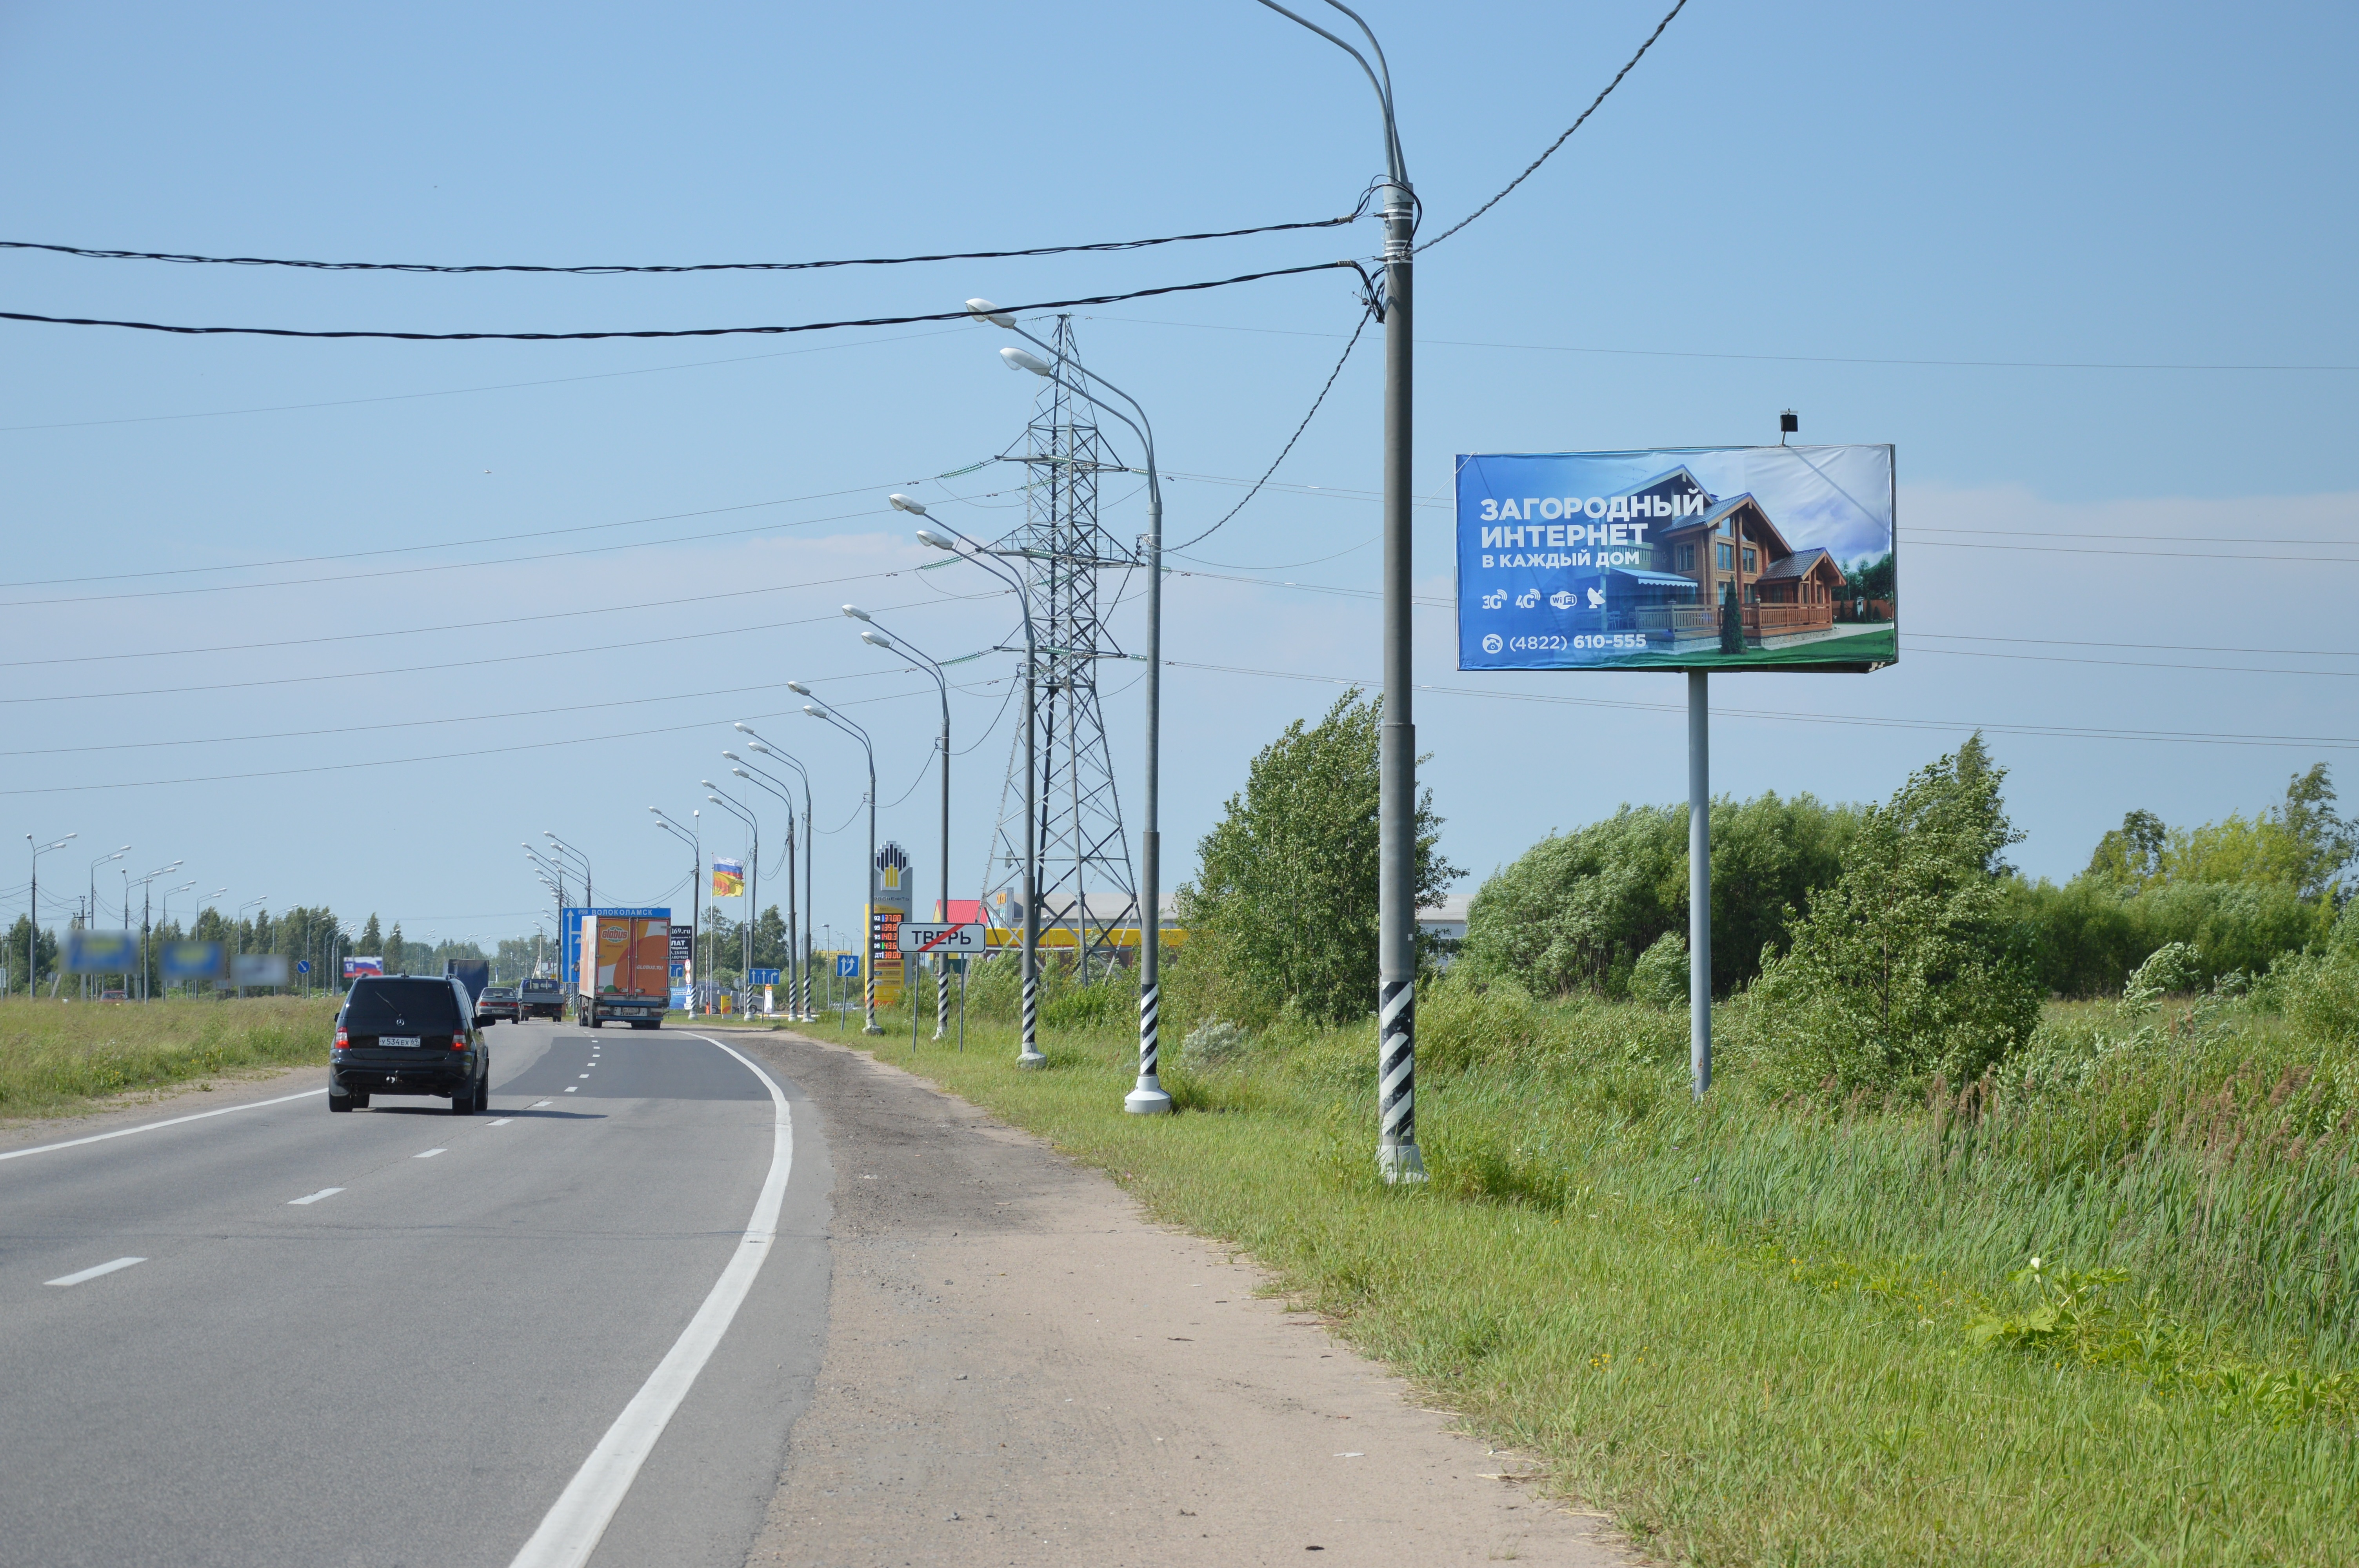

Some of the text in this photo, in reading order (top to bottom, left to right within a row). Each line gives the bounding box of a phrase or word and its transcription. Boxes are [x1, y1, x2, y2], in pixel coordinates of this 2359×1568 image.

[1480, 488, 1704, 522] ЗАГОРОДНЫЙ
[1481, 523, 1648, 548] ИНТЕРНЕТ
[1482, 549, 1639, 569] В КАЖДЫЙ ДОМ
[1482, 595, 1501, 609] 3G
[1515, 594, 1535, 608] 4G
[1509, 633, 1647, 652] (4822) 610-555
[911, 931, 971, 945] ТВЕРЬ
